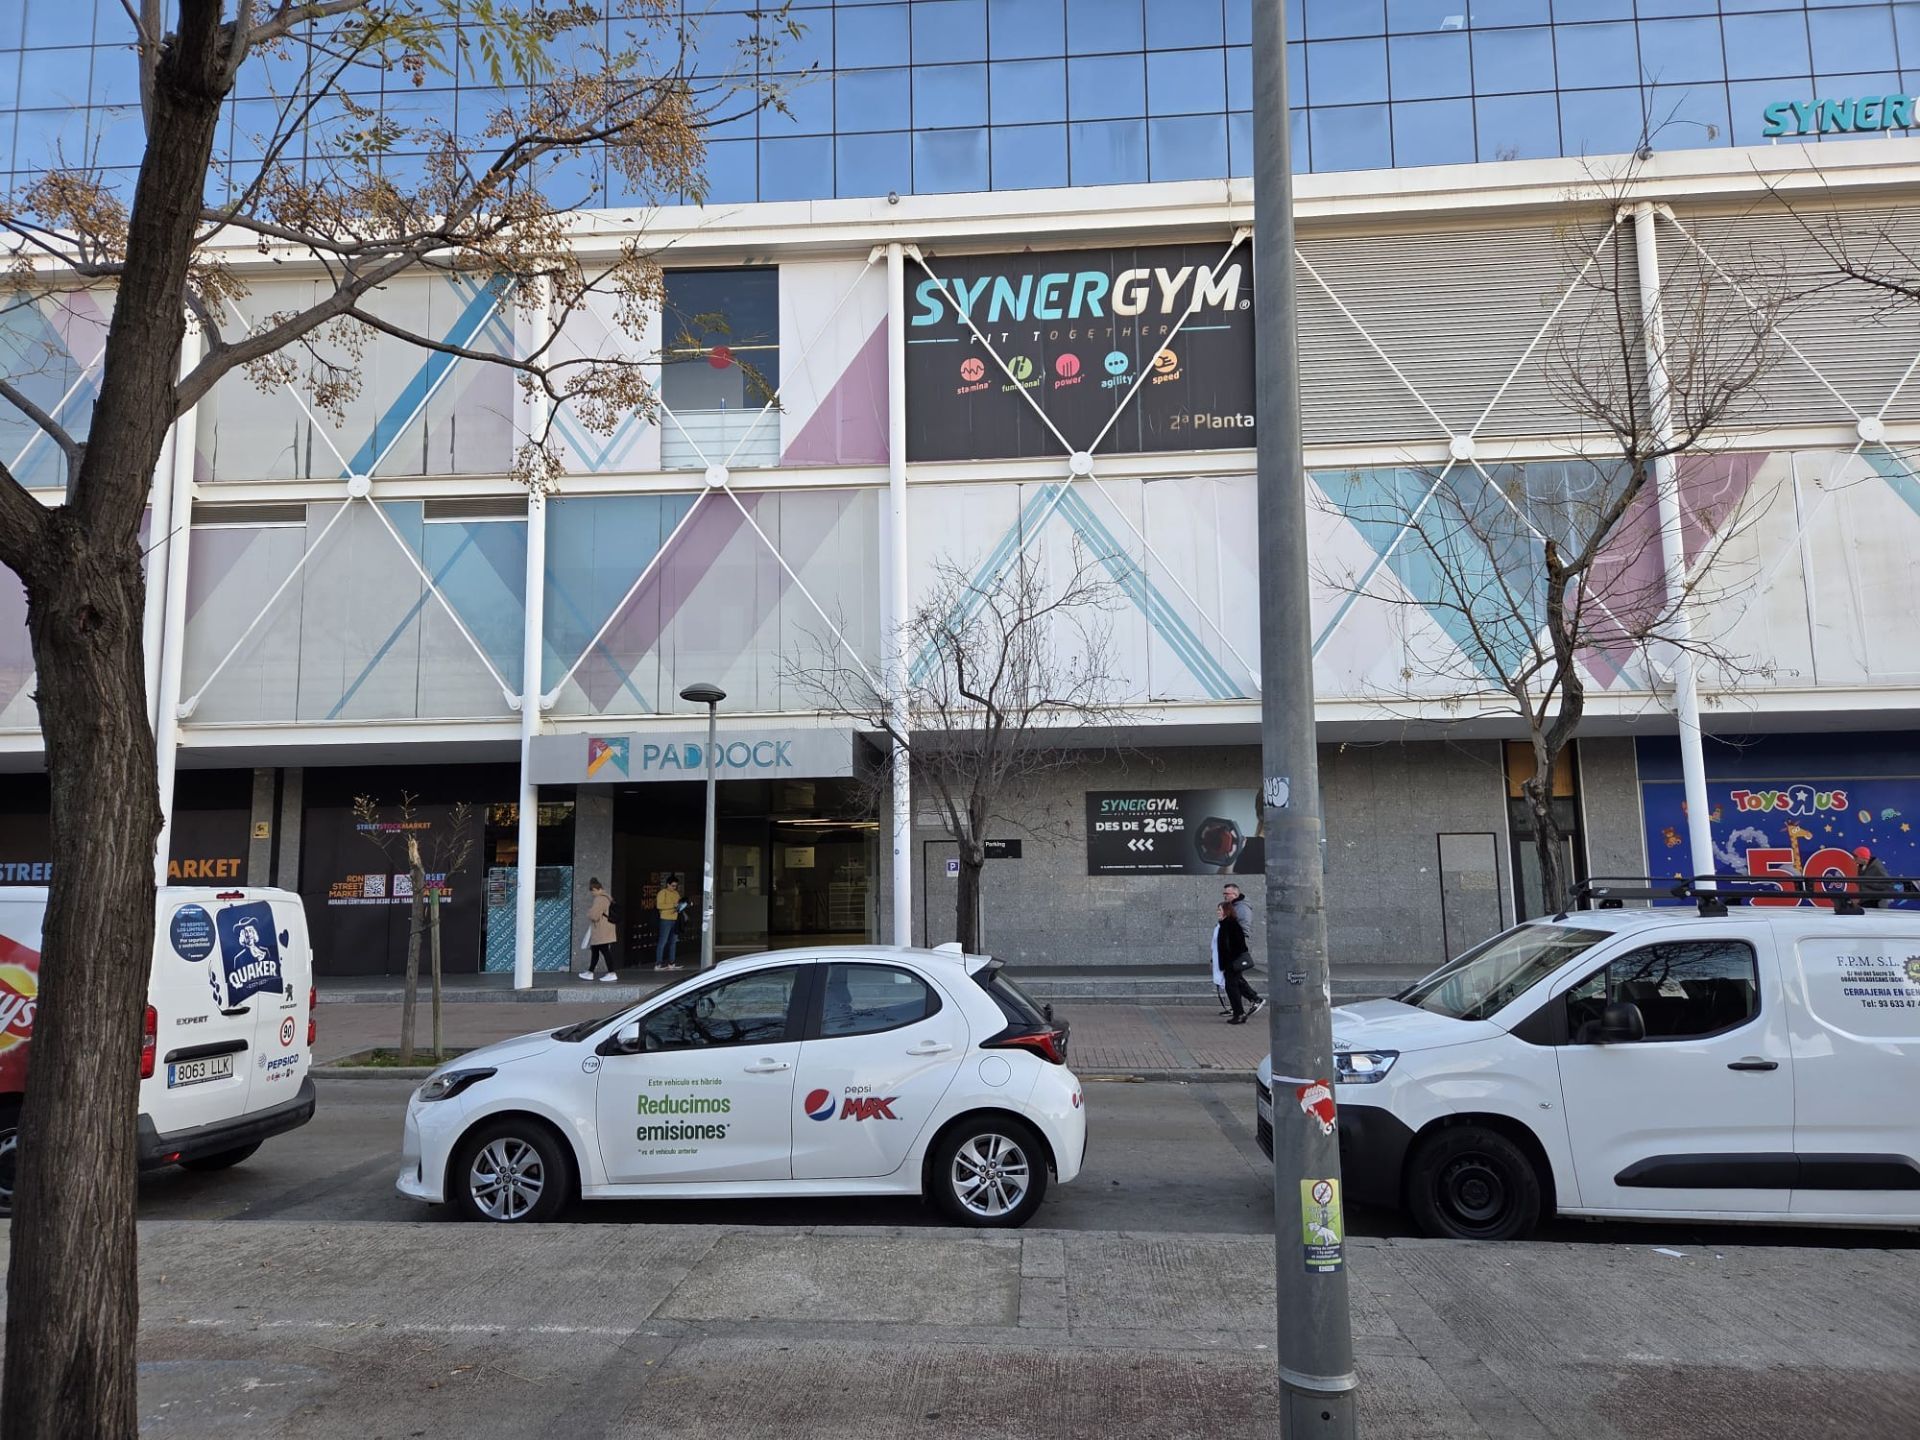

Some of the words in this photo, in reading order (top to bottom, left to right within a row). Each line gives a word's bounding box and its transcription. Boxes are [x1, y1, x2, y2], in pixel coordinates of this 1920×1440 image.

[1762, 94, 1920, 137] SYNER
[970, 332, 1010, 345] FIT
[1032, 325, 1170, 343] TOGETHER
[957, 382, 989, 395] stamina
[1054, 376, 1083, 390] power
[1101, 374, 1133, 389] agility
[1152, 371, 1181, 385] speed
[1194, 412, 1255, 429] Planta
[643, 740, 793, 771] PADDOCK
[1096, 821, 1121, 832] DES
[1122, 821, 1140, 831] DE
[1836, 956, 1874, 967] F.P.M.
[1876, 956, 1900, 967] S.L.
[229, 961, 277, 989] QUAKER
[1893, 988, 1905, 997] EN
[1861, 999, 1876, 1008] Tel:
[1889, 999, 1905, 1008] 633
[1906, 999, 1915, 1008] 47
[176, 1015, 208, 1025] EXPERT
[283, 1024, 292, 1038] 90
[178, 1062, 206, 1081] 8063
[211, 1057, 230, 1075] LLK
[267, 1053, 299, 1071] PEPSICO
[648, 1079, 665, 1087] Este
[844, 1084, 872, 1095] pepsi
[637, 1093, 731, 1116] Reducimos
[839, 1095, 903, 1122] MAX
